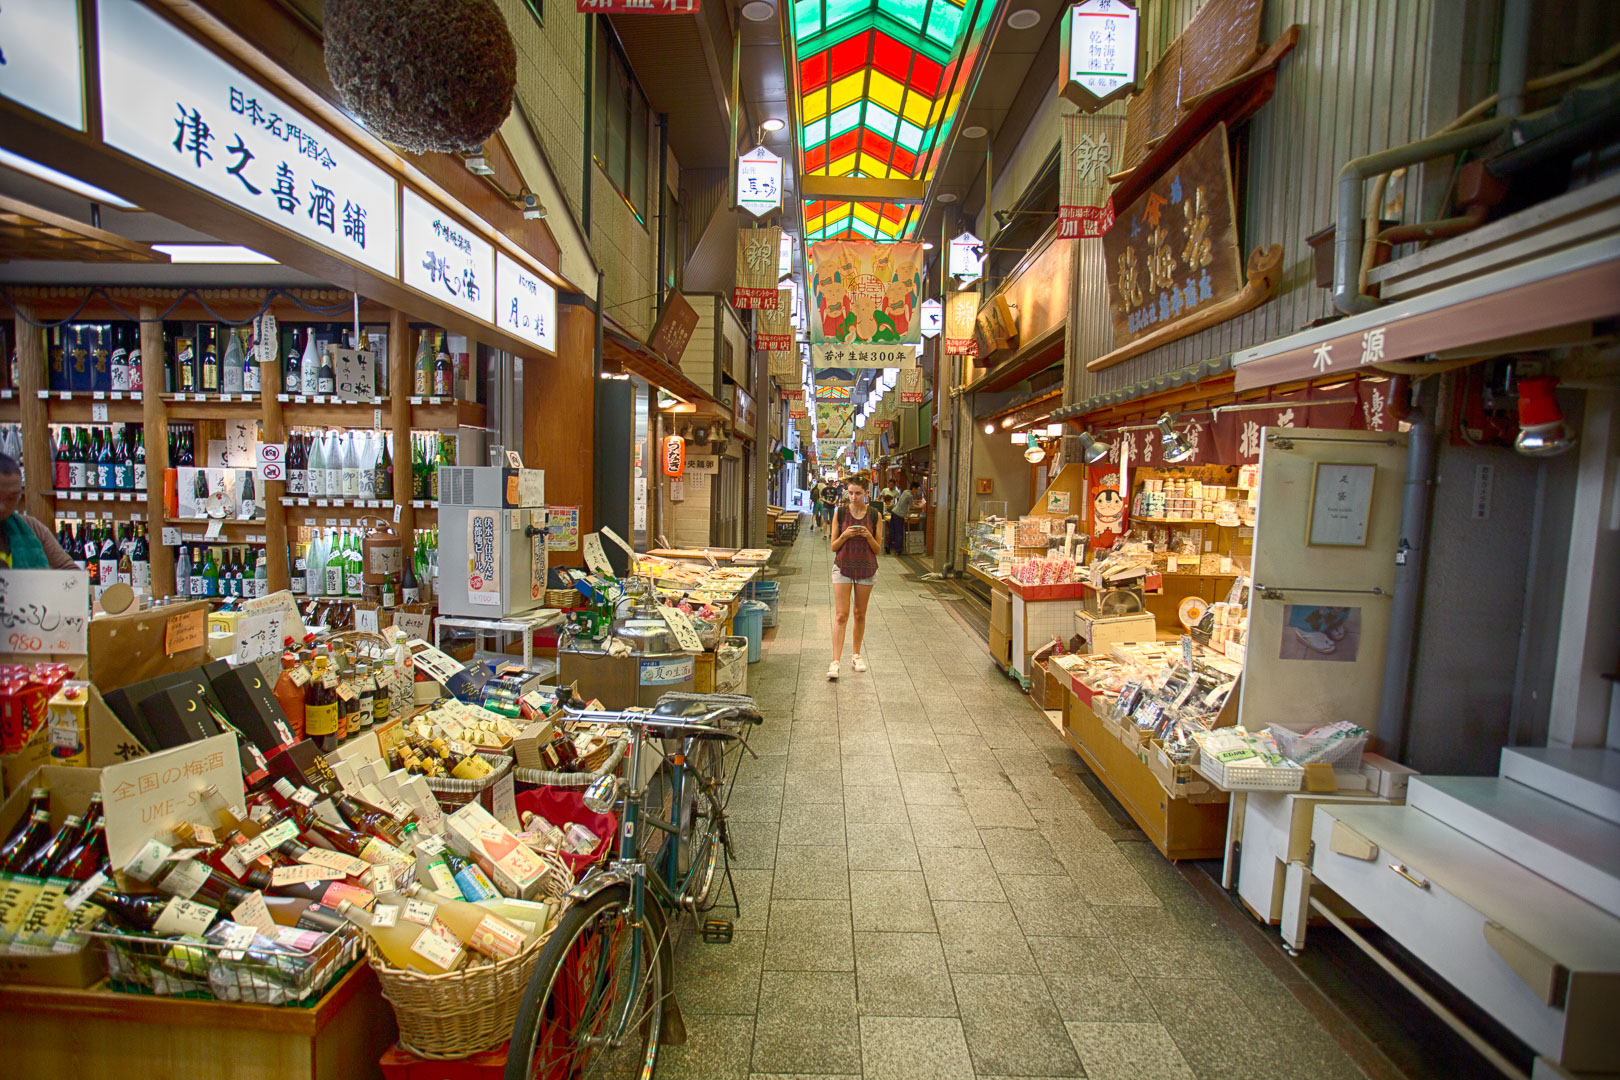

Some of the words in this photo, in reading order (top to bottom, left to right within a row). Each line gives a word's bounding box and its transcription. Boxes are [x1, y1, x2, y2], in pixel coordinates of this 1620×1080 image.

[229, 86, 337, 171] 日本名門酒会
[824, 351, 848, 361] 若冲
[1370, 387, 1384, 432] 島本
[667, 440, 681, 472] うなぎ
[684, 460, 714, 469] 央鶏卵
[484, 517, 494, 581] 伏水で仕込んだ
[8, 632, 42, 652] 980
[112, 751, 225, 803] 全国の梅酒
